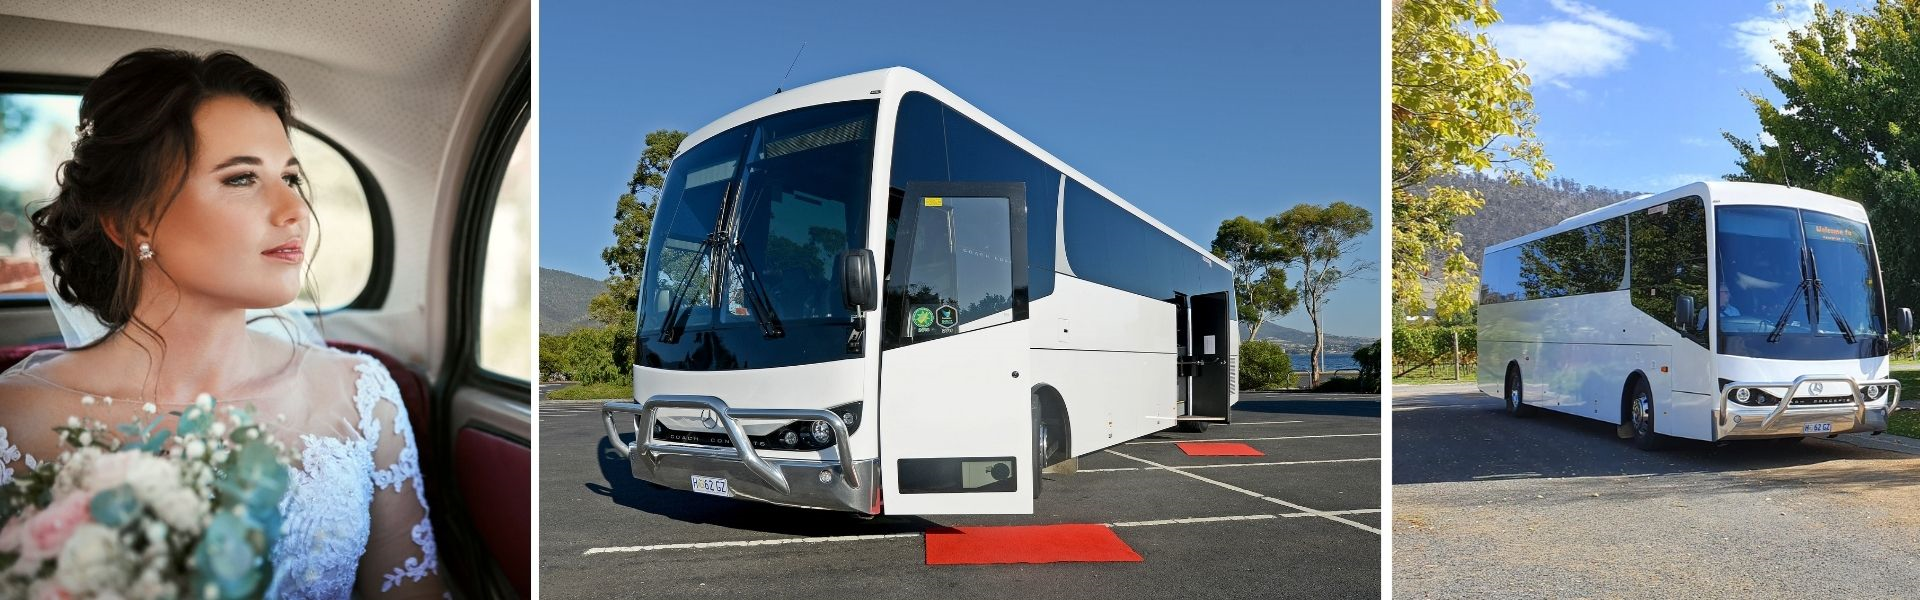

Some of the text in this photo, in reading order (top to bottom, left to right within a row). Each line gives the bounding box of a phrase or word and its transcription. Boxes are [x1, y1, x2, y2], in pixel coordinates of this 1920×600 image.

[1814, 423, 1821, 431] 62
[704, 479, 715, 491] 62
[715, 480, 727, 493] GZ
